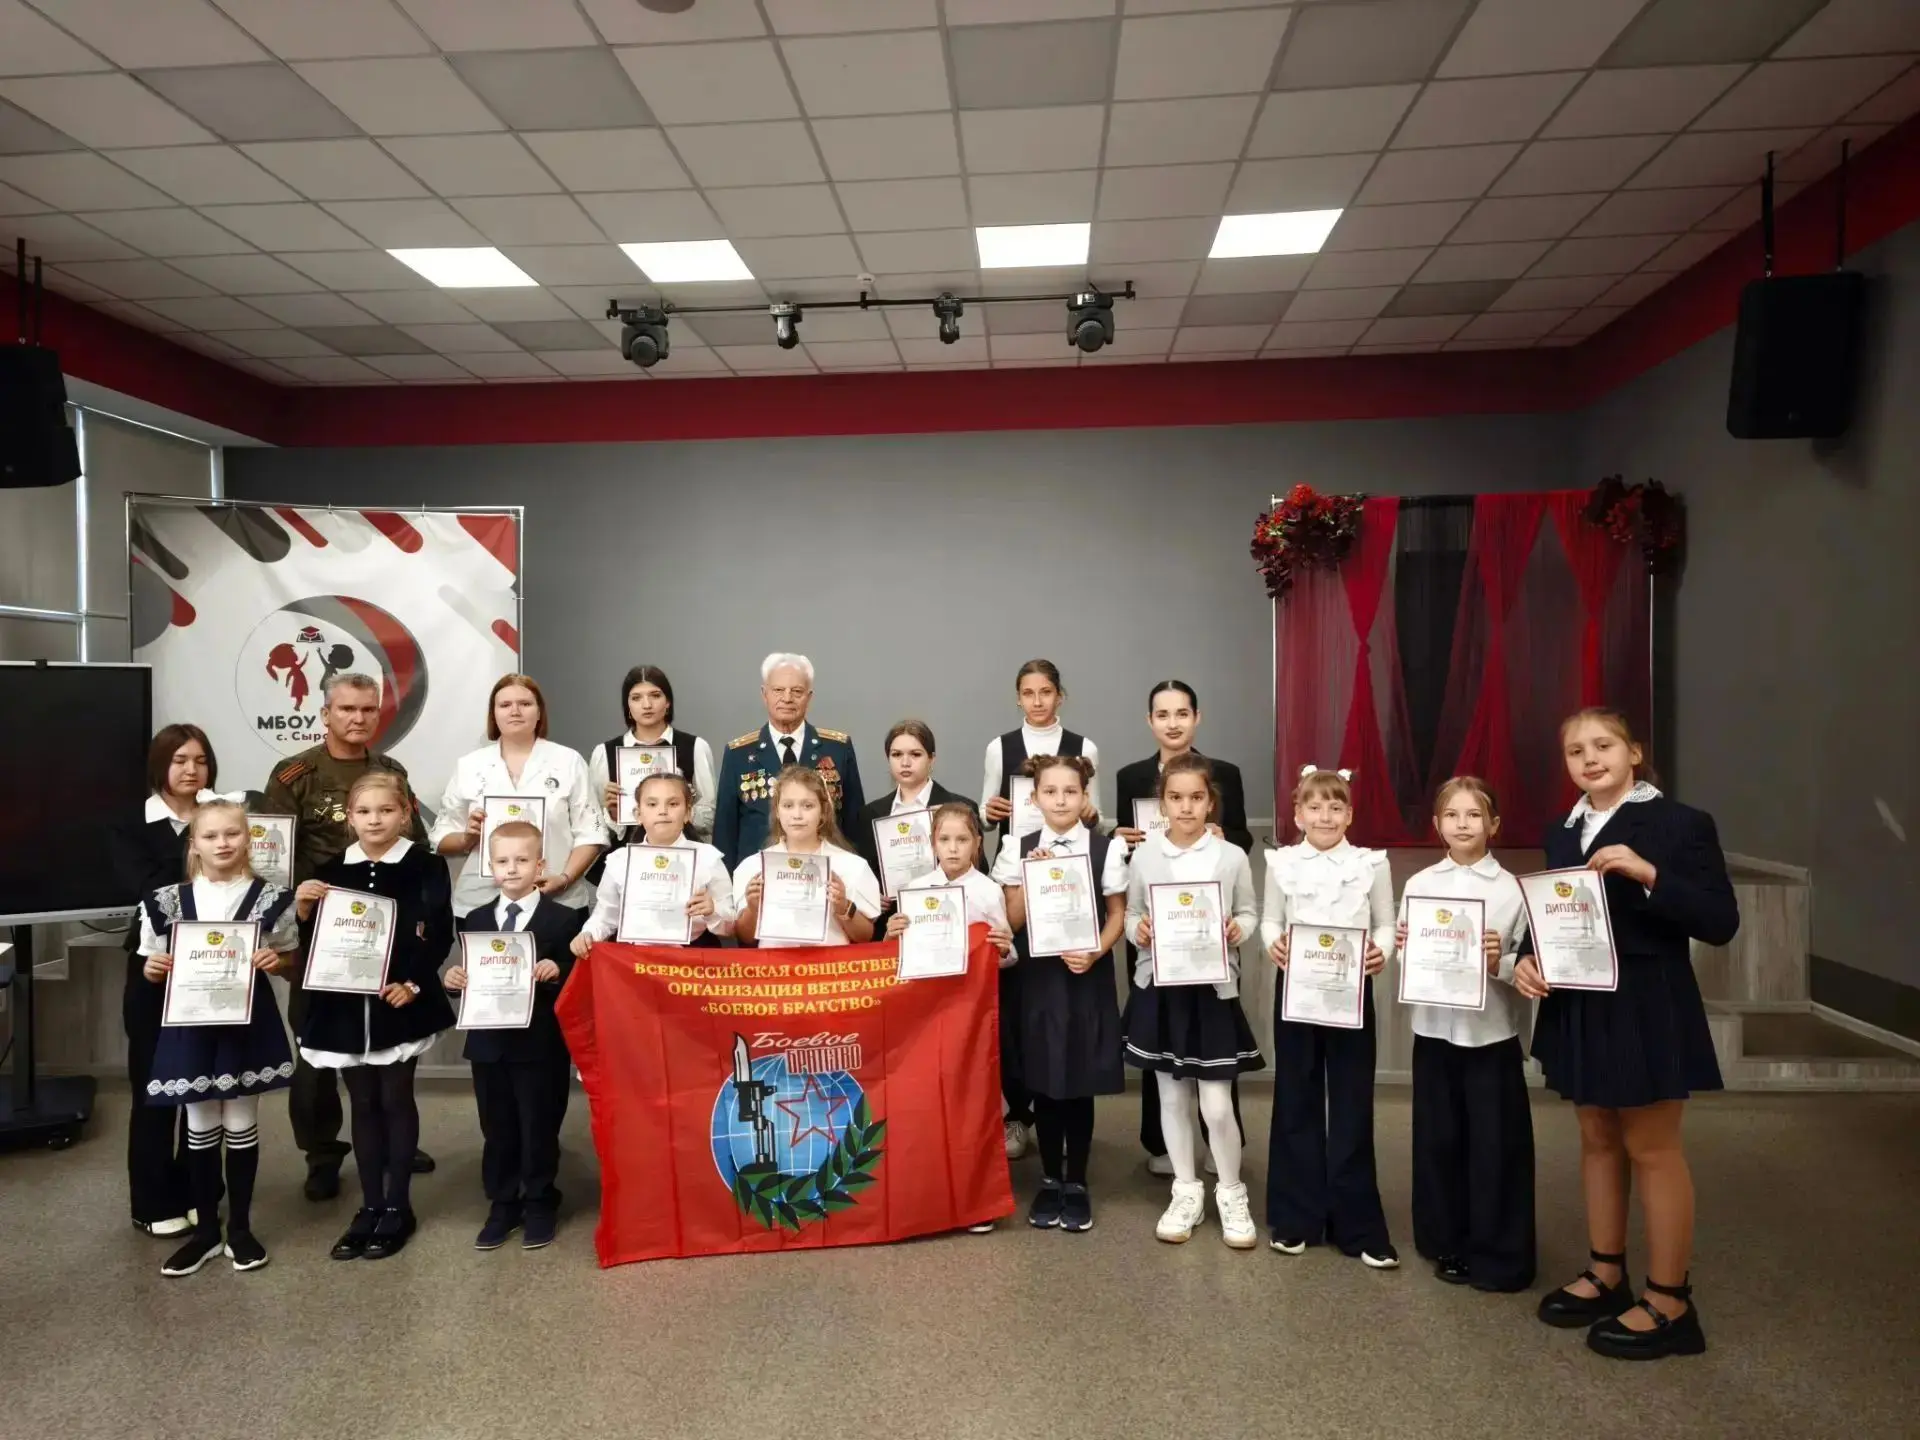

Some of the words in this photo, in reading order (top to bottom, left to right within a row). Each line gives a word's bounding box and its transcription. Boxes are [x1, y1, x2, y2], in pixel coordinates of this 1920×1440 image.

[257, 715, 316, 730] МБОУ
[291, 731, 328, 742] Сыро
[640, 872, 679, 881] ДИПЛОМ
[776, 871, 814, 882] ДИПЛОМ
[1040, 883, 1077, 895] ДИПЛОМ
[1545, 902, 1589, 915] ДИПЛОМ
[914, 912, 951, 924] ДИПЛОМ
[1167, 910, 1207, 920] ДИПЛОМ
[334, 917, 377, 930] ДИПЛОМ
[1420, 927, 1466, 939] ДИПЛОМ
[189, 950, 236, 960] ДИПЛОМ
[480, 956, 519, 966] ДИПЛОМ
[1304, 949, 1346, 961] ДИПЛОМ
[634, 962, 790, 979] ВСЕРОССИЙСКАЯ
[668, 982, 803, 999] ОРГАНИЗАЦИЯ
[807, 974, 909, 996] ВЕТЕРАНО
[701, 1002, 779, 1016] «БОЕВОЕ
[782, 995, 882, 1015] БРАТСТВО»
[751, 1031, 860, 1048] Боевое
